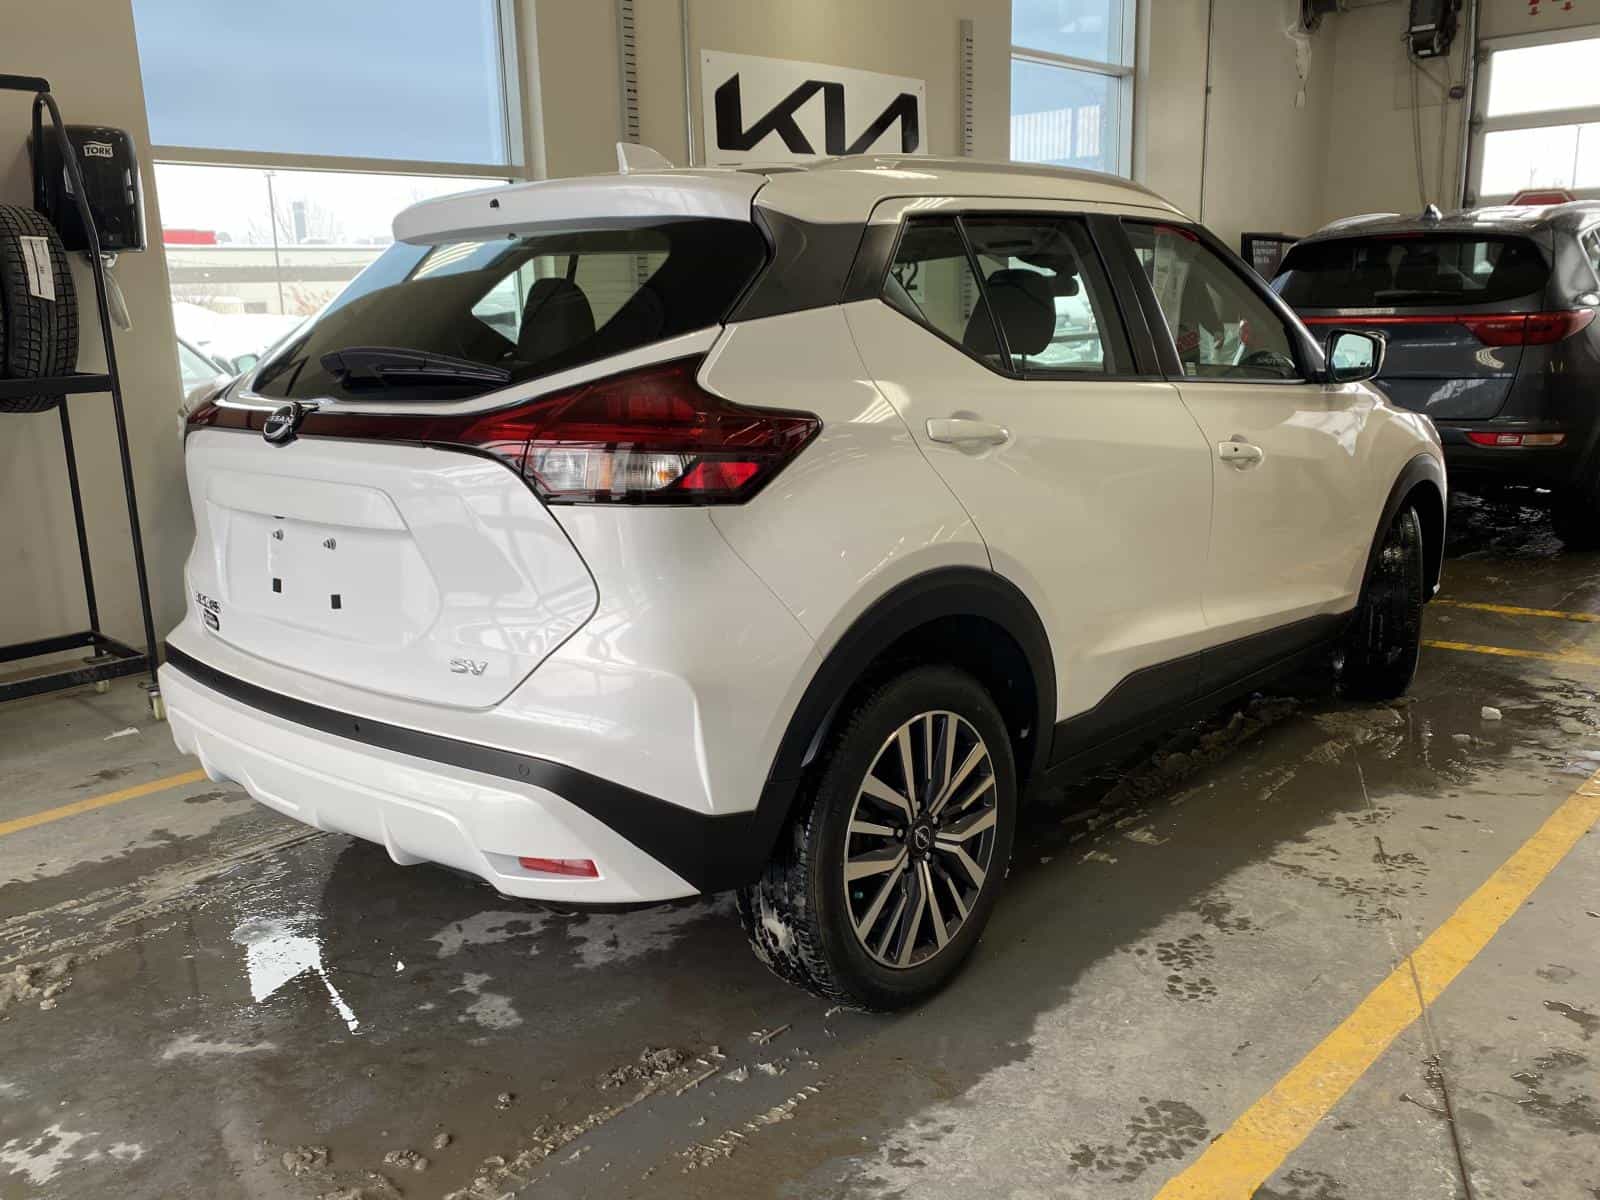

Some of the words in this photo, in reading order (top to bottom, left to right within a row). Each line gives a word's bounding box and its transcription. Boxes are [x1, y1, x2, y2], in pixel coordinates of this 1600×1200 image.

[714, 71, 919, 157] KIA
[85, 145, 113, 157] TORK
[449, 658, 489, 677] SV
